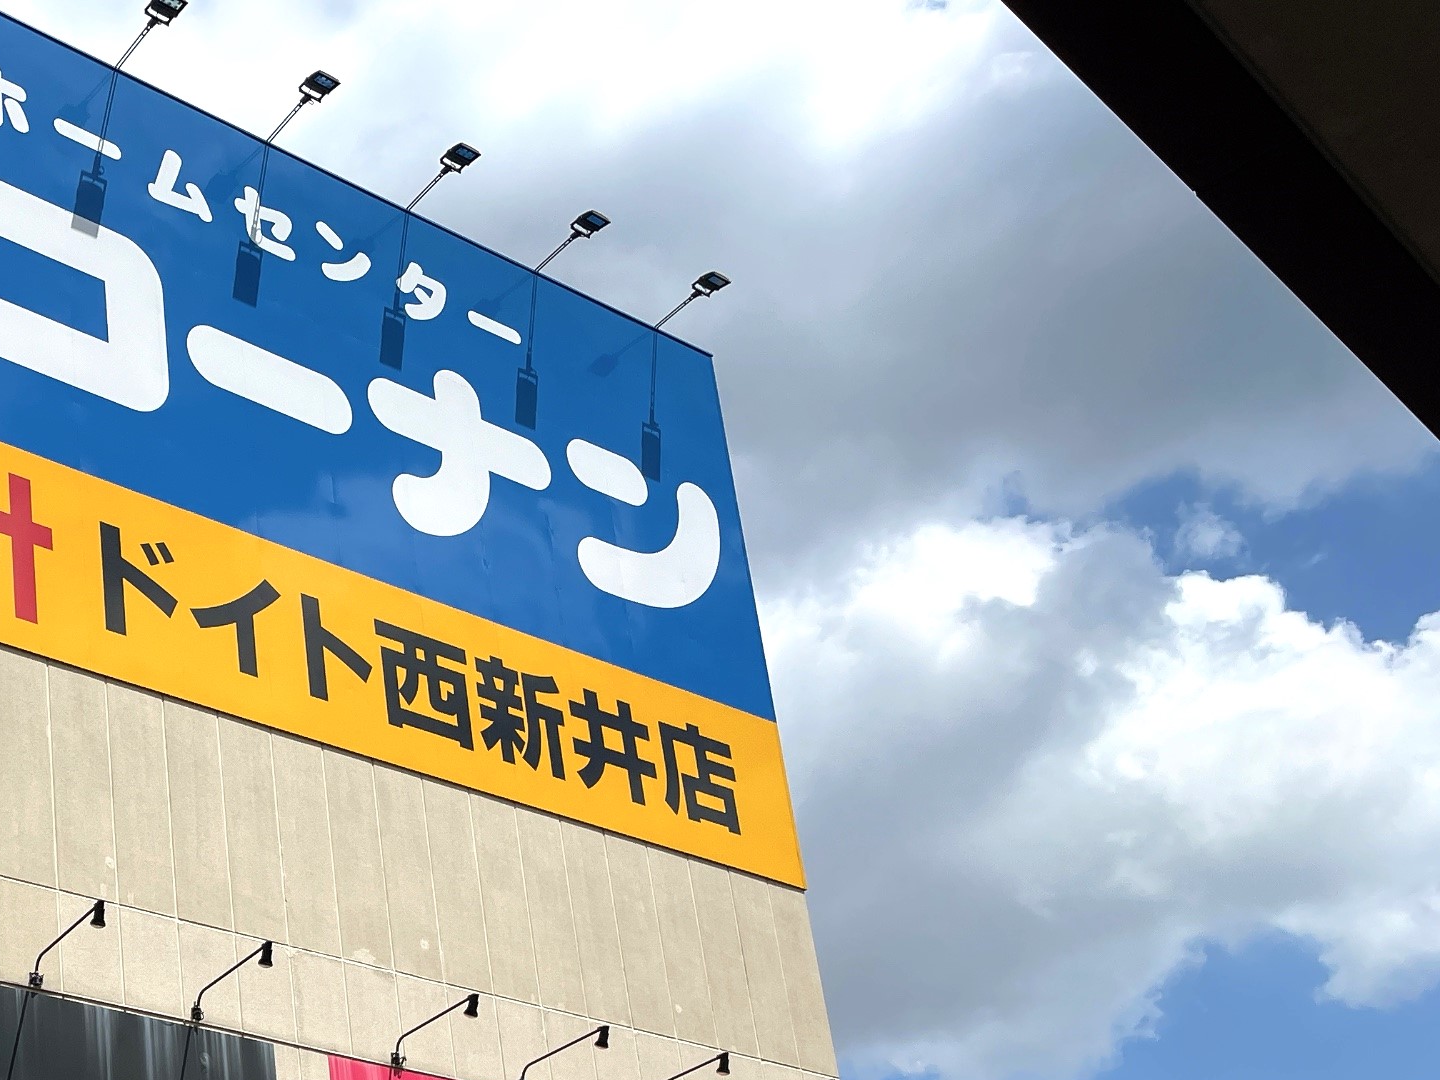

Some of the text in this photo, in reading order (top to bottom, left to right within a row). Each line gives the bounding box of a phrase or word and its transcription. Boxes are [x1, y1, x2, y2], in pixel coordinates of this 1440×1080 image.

[100, 520, 742, 835] ドイト西新井店
